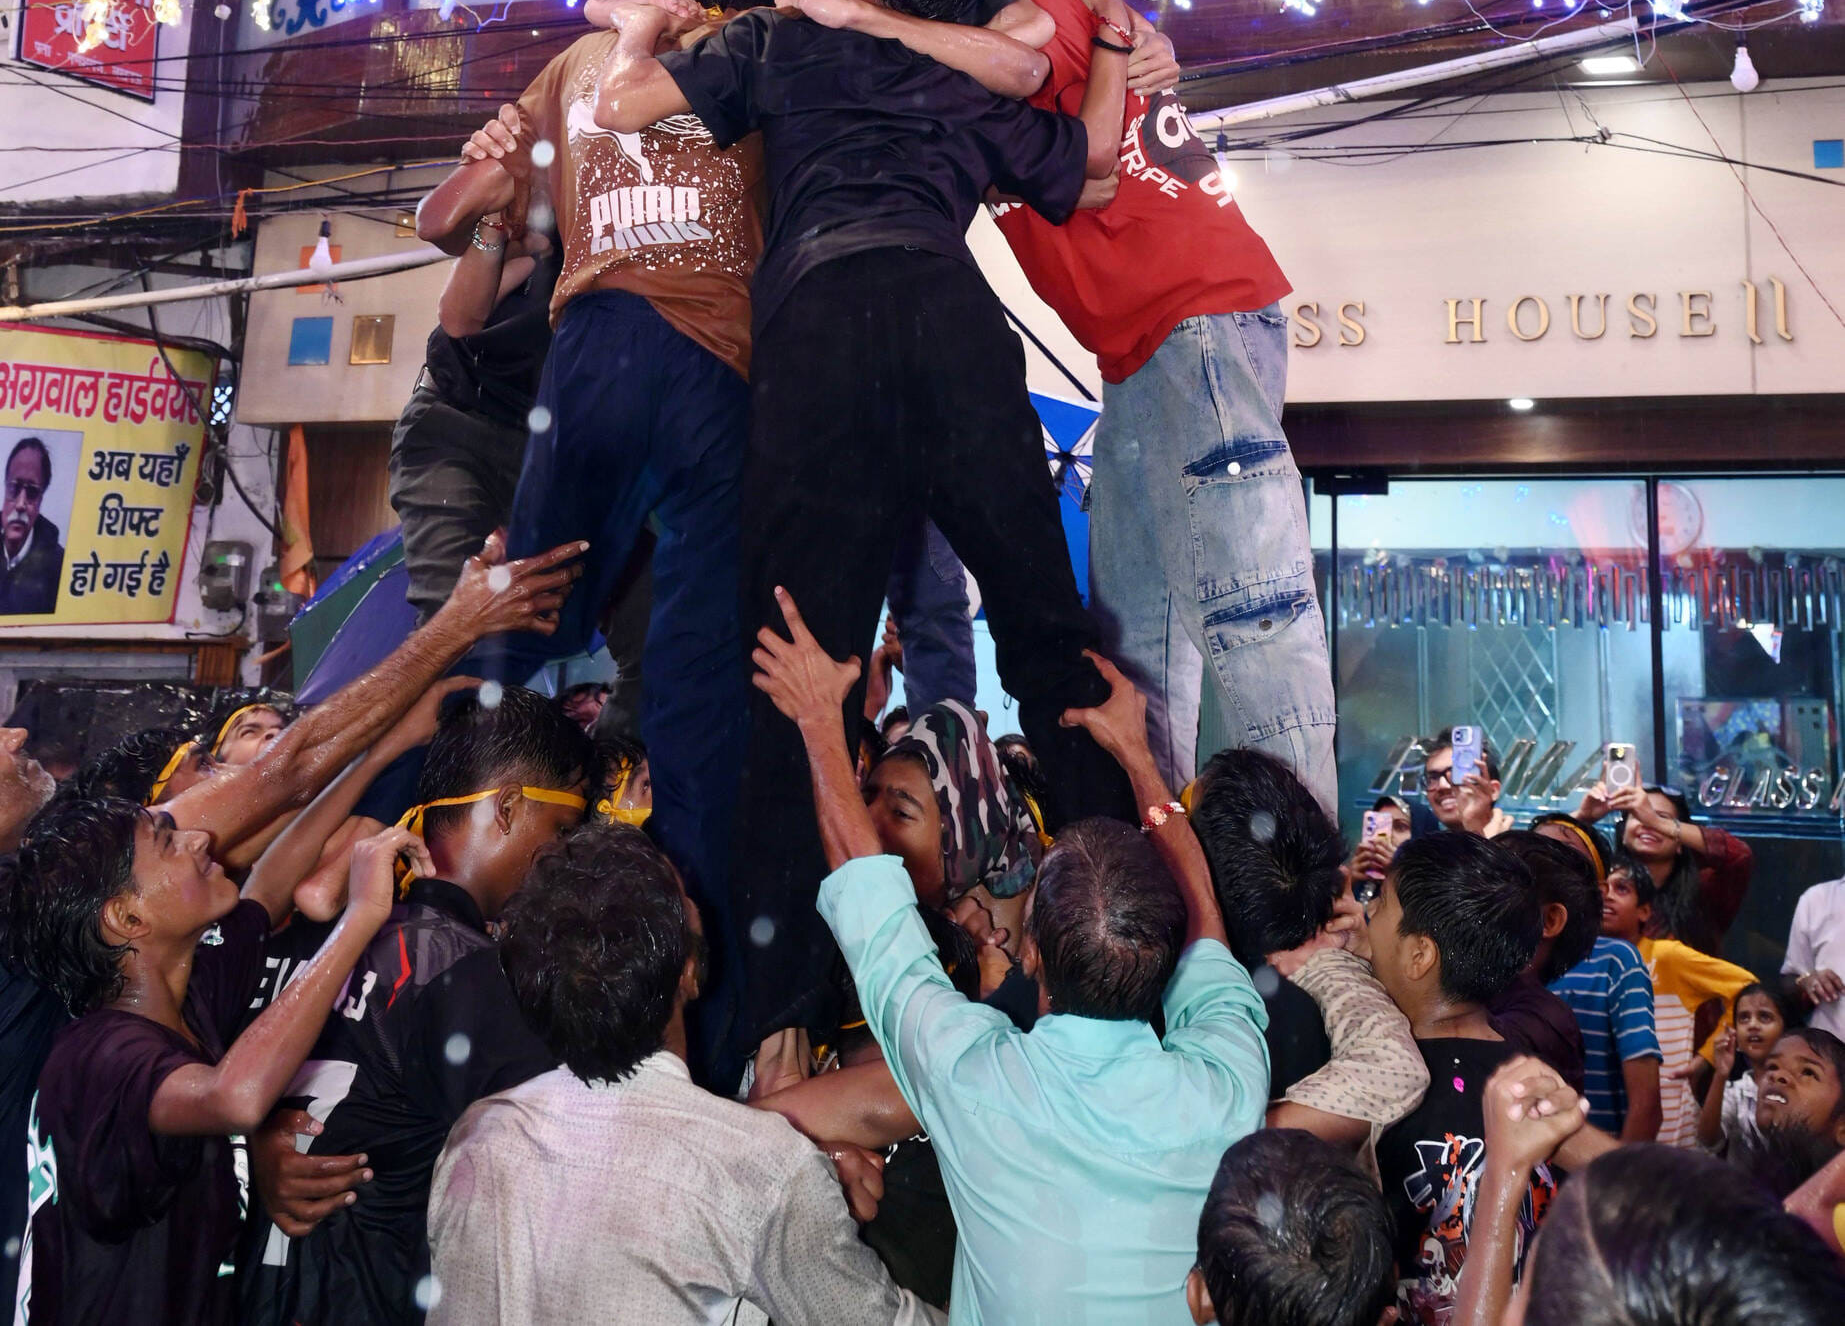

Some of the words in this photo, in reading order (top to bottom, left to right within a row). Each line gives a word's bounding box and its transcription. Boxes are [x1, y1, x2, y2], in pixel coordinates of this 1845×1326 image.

[589, 185, 701, 241] PUMA
[1443, 289, 1717, 344] HOUSE
[0, 361, 105, 422] अग्रवाल
[88, 450, 135, 482] अब
[138, 442, 191, 488] यहाँ
[97, 492, 165, 538] शिफ्ट
[69, 551, 101, 597] हो
[102, 550, 150, 599] गई
[149, 550, 171, 596] है
